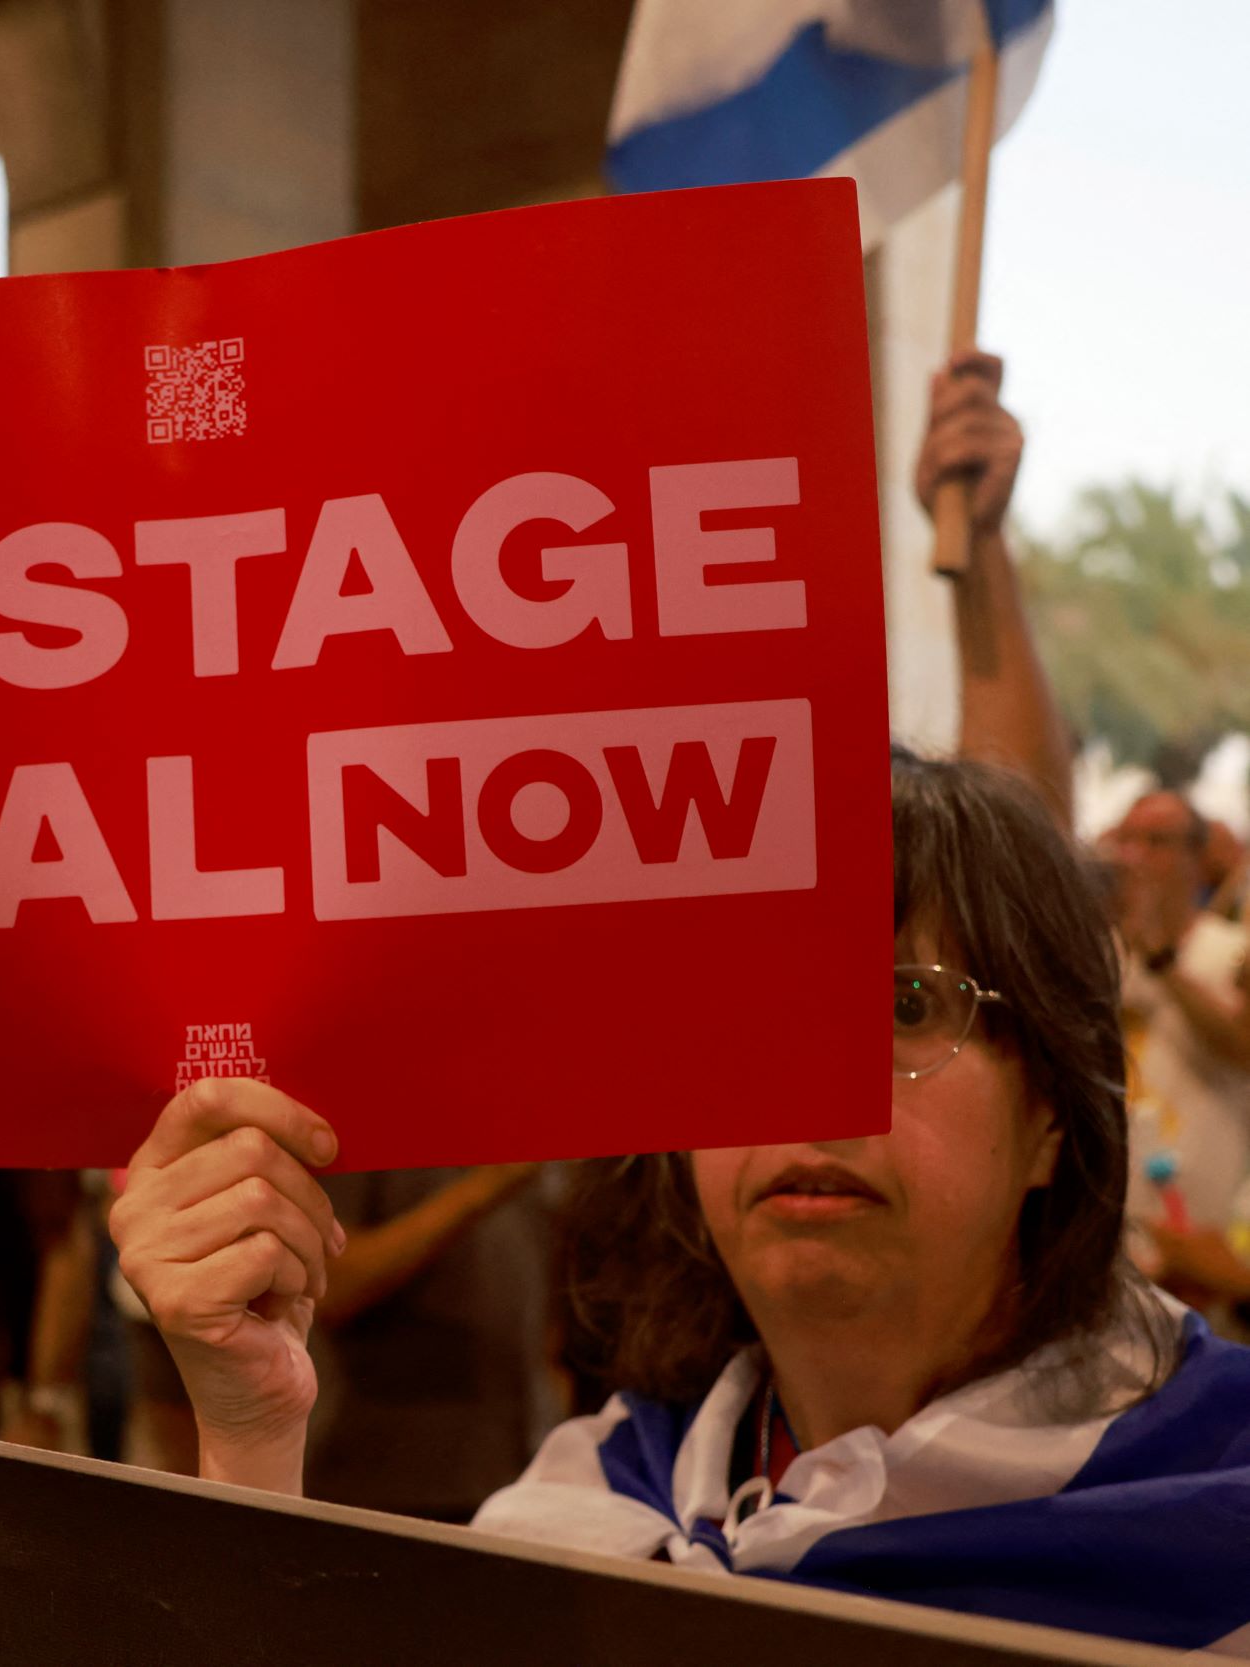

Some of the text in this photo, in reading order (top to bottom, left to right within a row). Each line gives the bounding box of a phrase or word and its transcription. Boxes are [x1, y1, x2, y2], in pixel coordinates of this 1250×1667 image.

[341, 736, 778, 885] NOW
[185, 1023, 253, 1042] מחאת
[185, 1040, 255, 1060] הנשים
[176, 1056, 267, 1078] להחזרת
